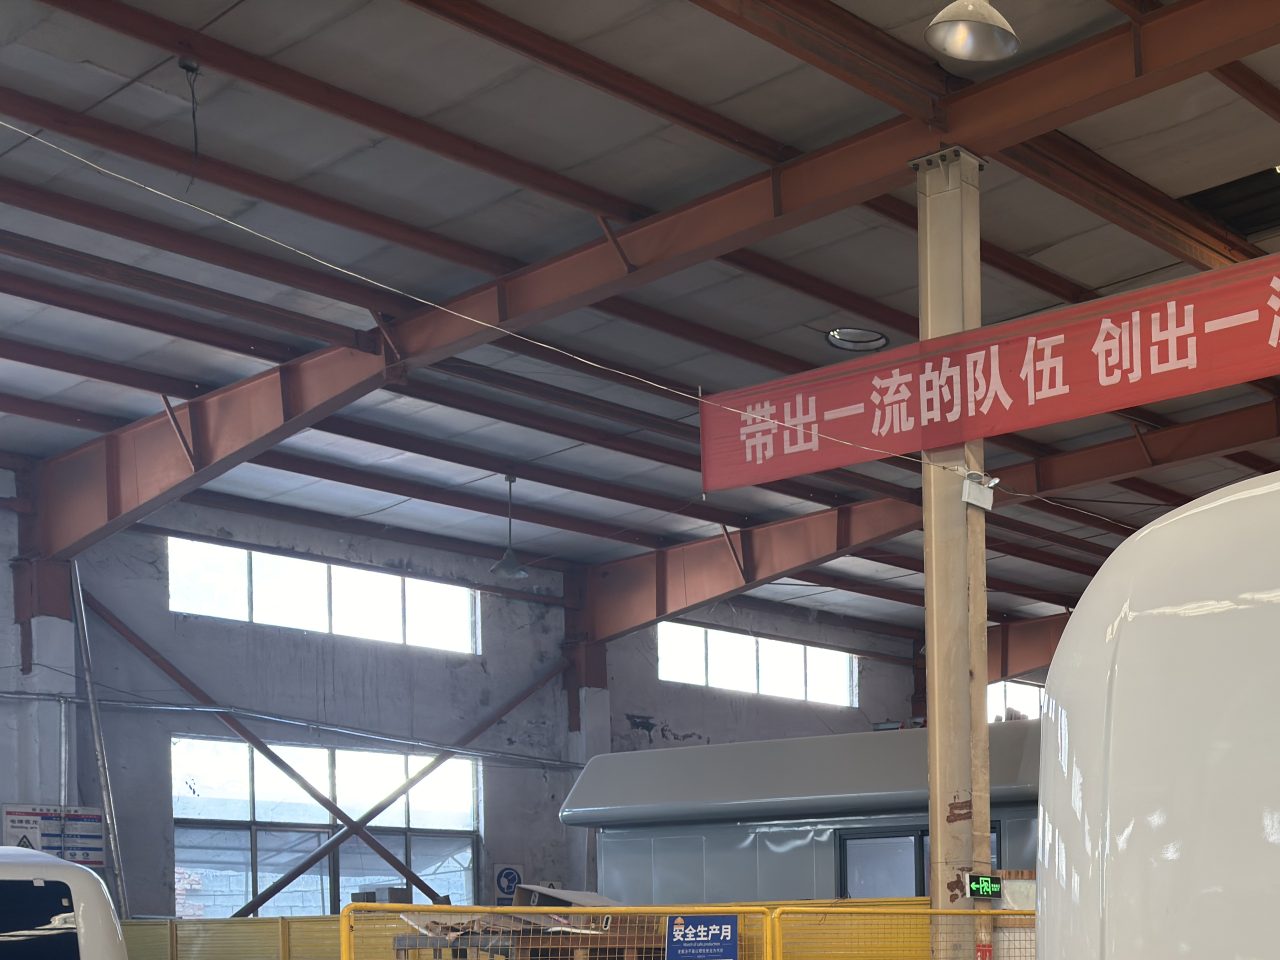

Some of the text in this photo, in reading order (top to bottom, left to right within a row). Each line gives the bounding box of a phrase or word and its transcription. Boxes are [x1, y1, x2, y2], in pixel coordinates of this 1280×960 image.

[740, 334, 1070, 464] 带出一流的队伍
[672, 924, 732, 942] 安全生产月
